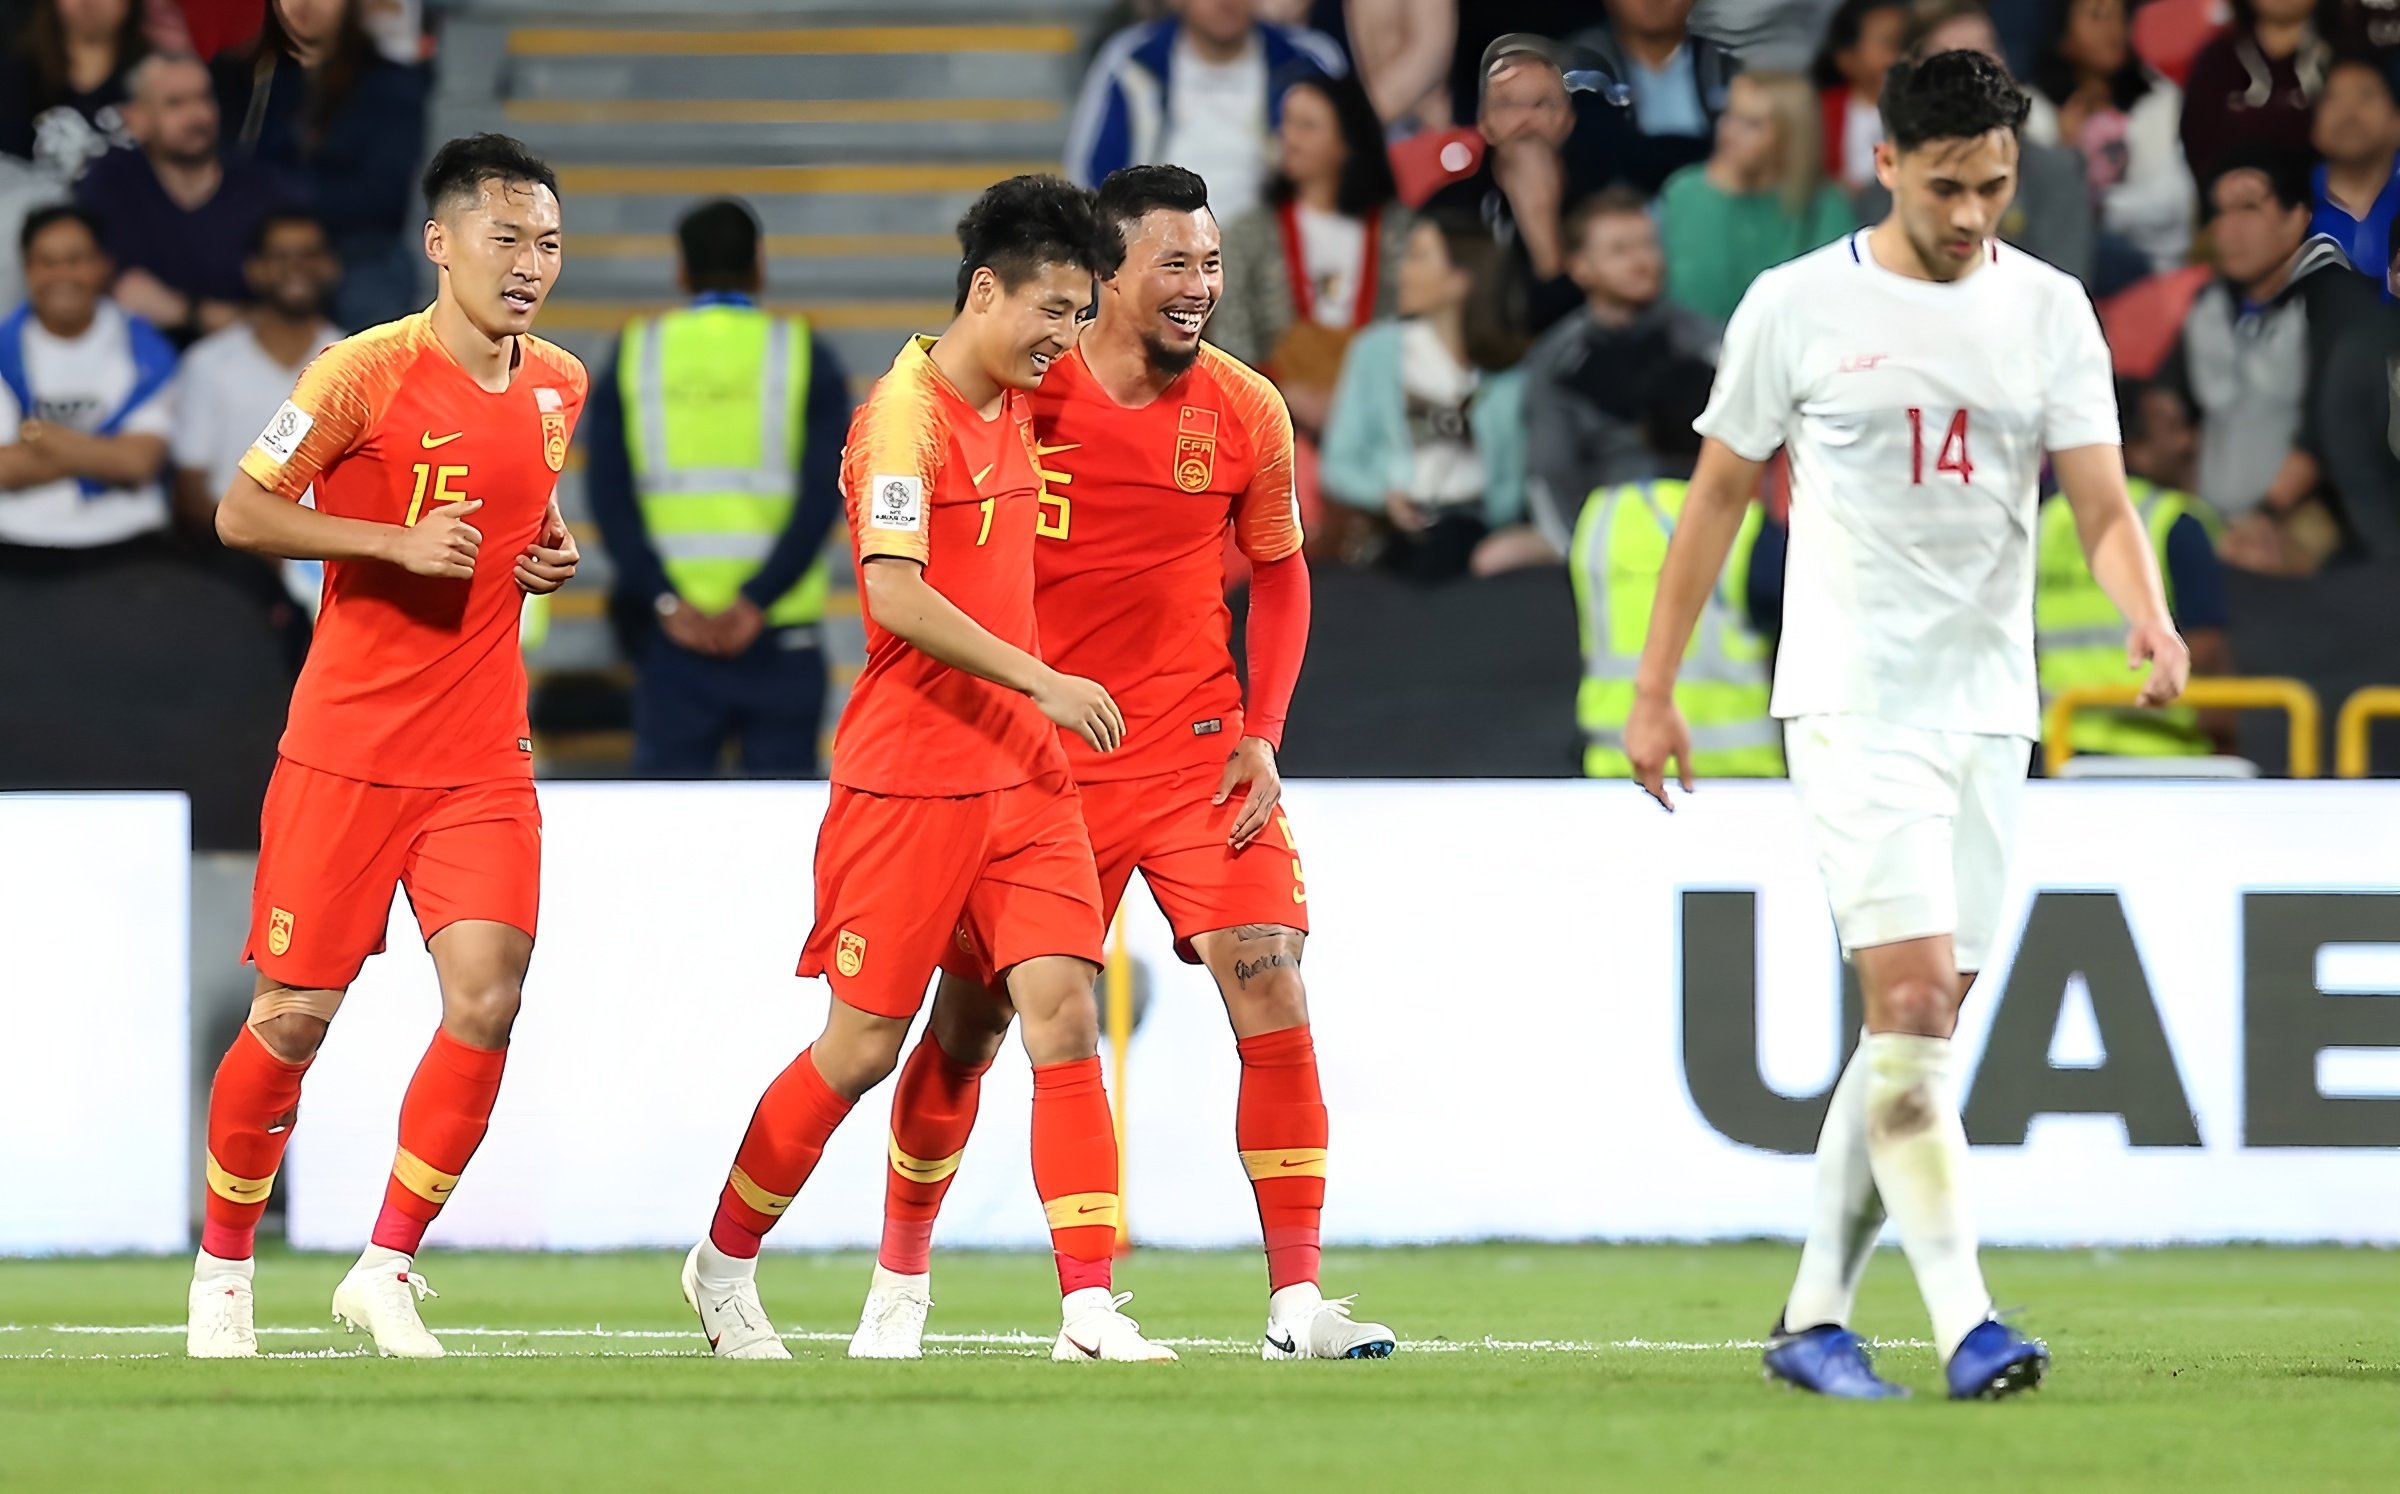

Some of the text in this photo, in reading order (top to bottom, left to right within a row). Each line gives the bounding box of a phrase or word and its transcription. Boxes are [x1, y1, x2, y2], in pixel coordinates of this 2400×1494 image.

[1907, 408, 1973, 484] 14
[1035, 469, 1073, 540] 5
[1682, 891, 2400, 1154] UAE
